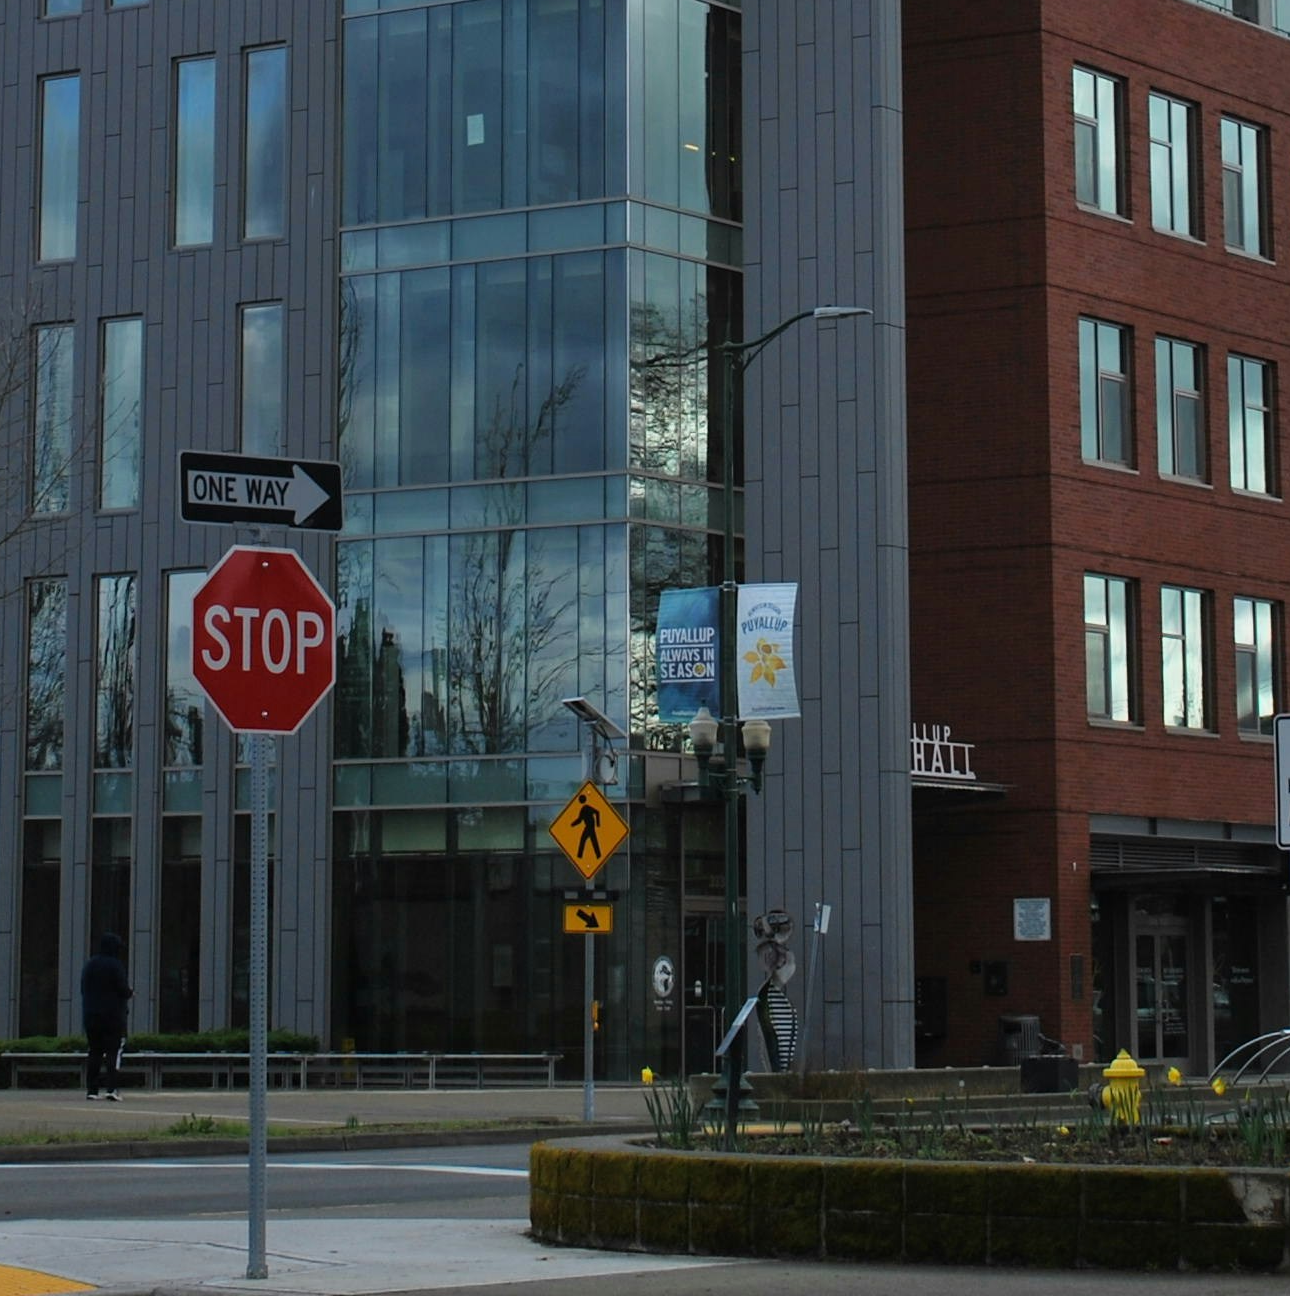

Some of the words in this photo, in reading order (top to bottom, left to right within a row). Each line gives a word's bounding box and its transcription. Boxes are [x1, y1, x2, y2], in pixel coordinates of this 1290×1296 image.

[193, 473, 237, 503] ONE
[246, 477, 290, 506] WAY
[741, 616, 788, 634] PUYALLUP
[201, 604, 325, 674] STOP
[660, 627, 715, 644] PUYALLUP
[660, 648, 701, 662] ALWAYS
[703, 647, 715, 662] IN
[660, 662, 715, 678] SEASON
[912, 722, 951, 742] LLUP
[913, 740, 975, 776] HALL
